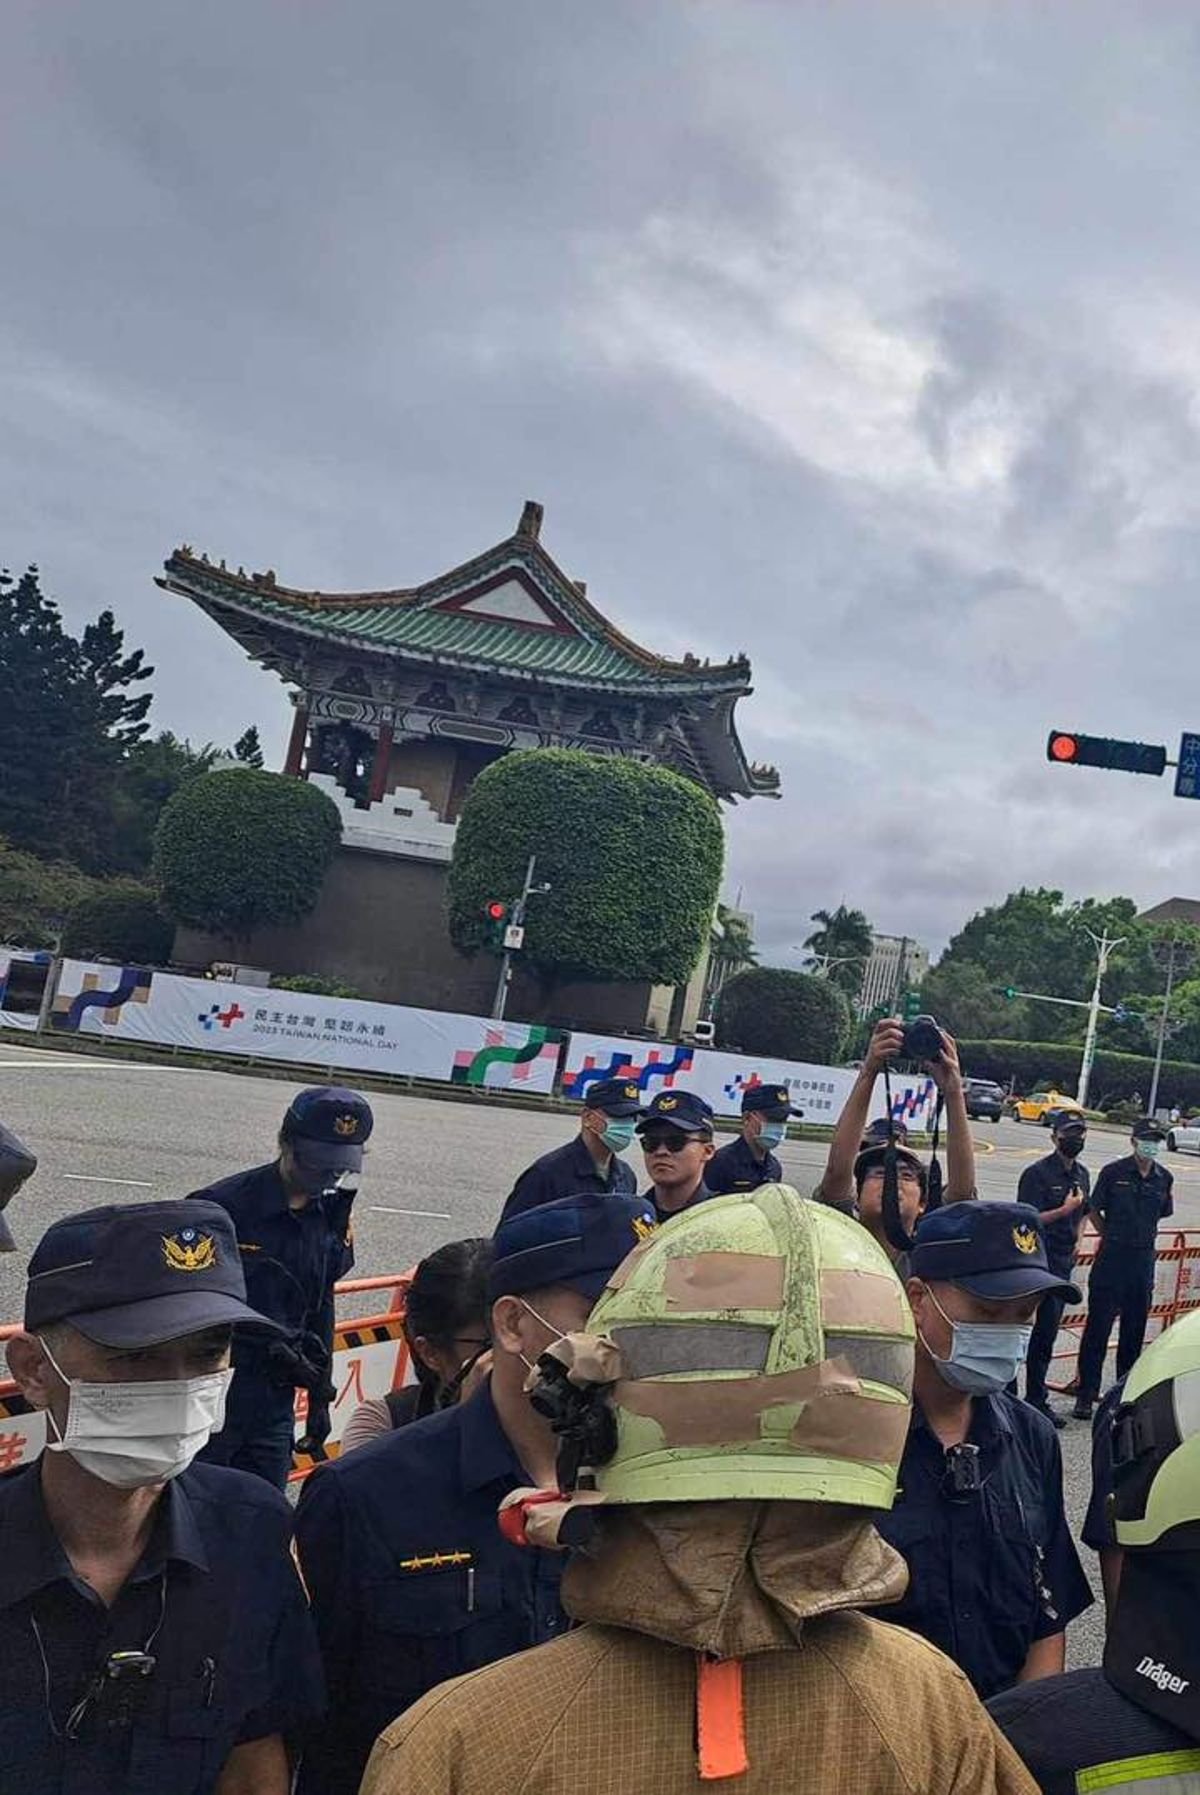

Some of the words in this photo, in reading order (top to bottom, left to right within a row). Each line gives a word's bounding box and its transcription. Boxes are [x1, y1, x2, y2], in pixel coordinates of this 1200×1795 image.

[254, 1009, 317, 1027] 民主台灣
[280, 1028, 321, 1041] TAIWAN
[322, 1034, 375, 1048] NATIONAL
[377, 1040, 399, 1050] DAY
[1136, 1656, 1190, 1694] Dräger
